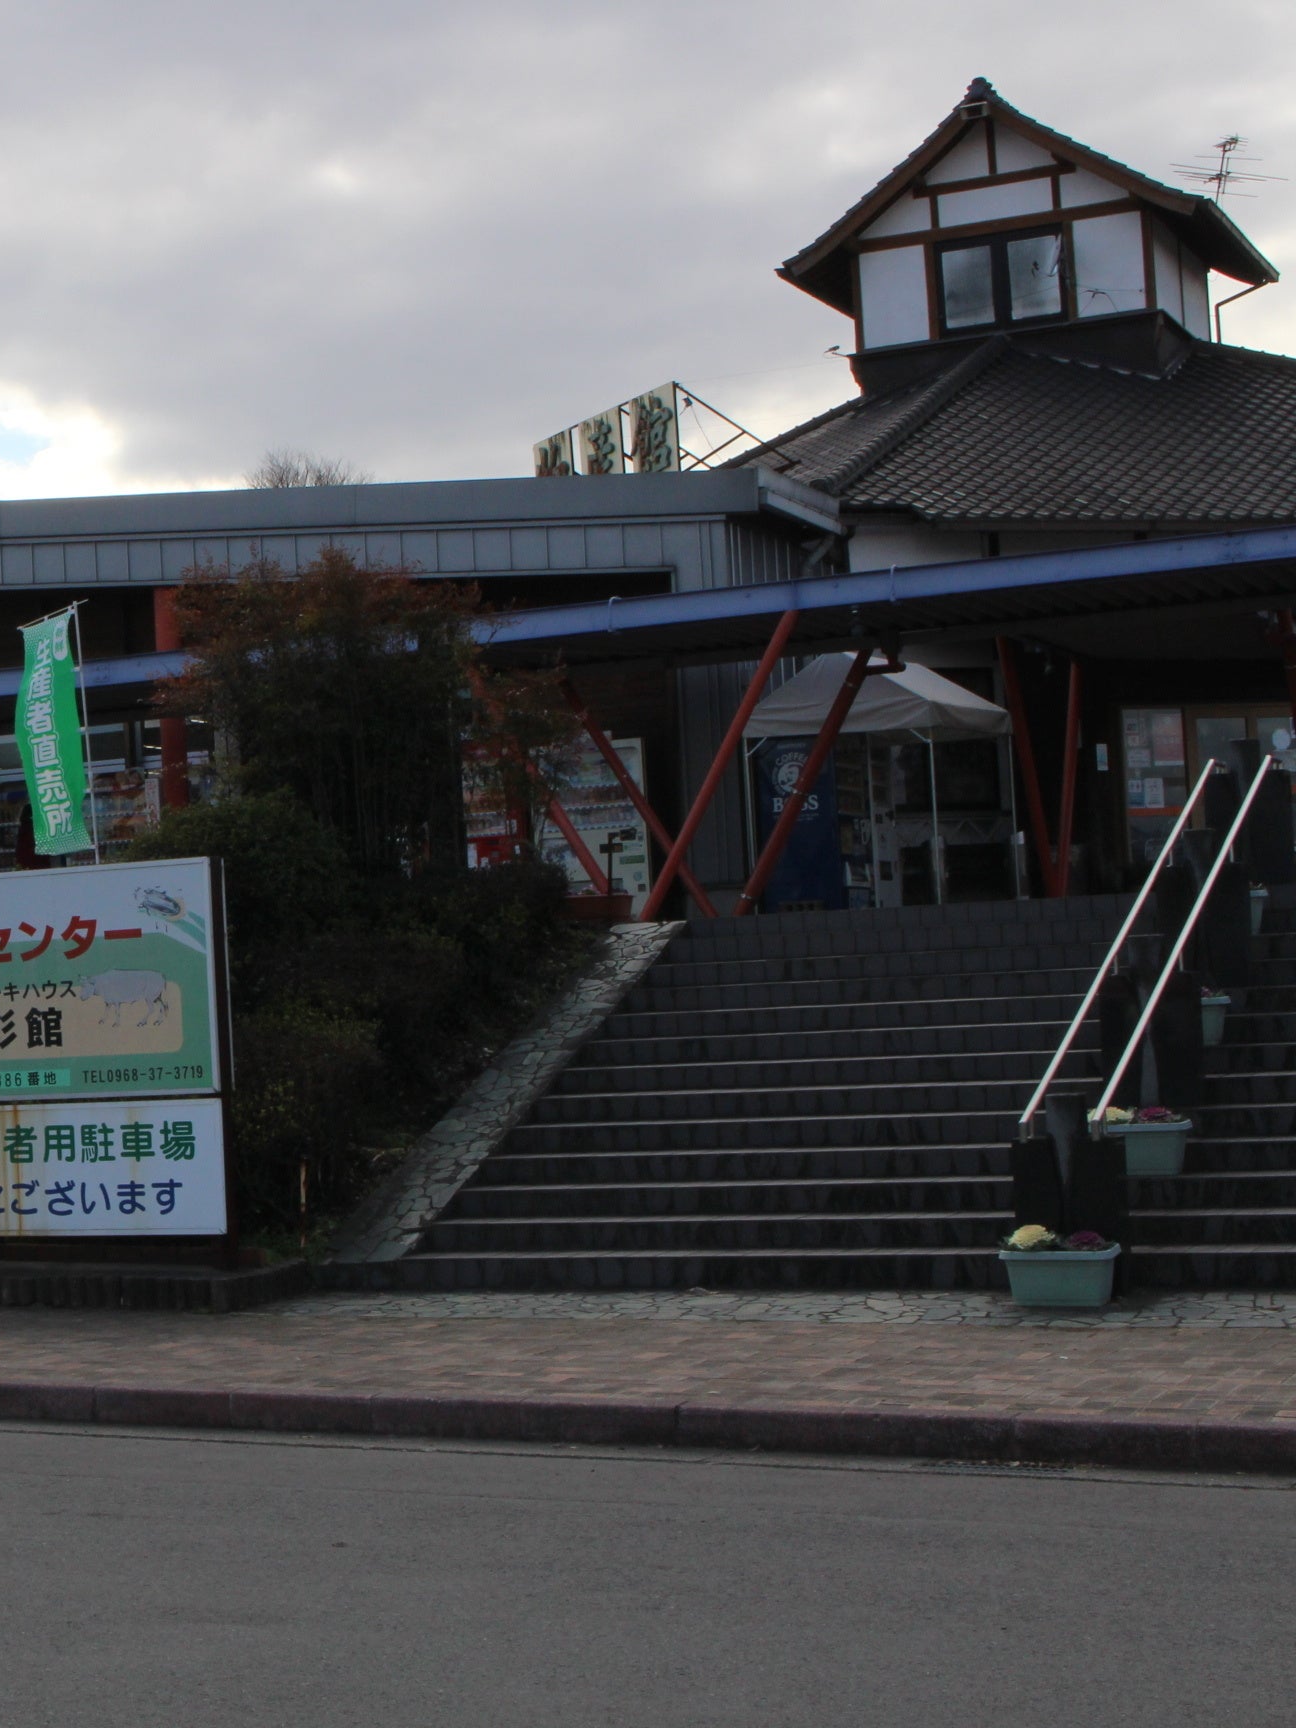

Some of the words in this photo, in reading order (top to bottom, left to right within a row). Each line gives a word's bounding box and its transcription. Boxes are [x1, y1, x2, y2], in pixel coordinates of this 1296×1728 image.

[25, 638, 73, 837] 生産者直売所
